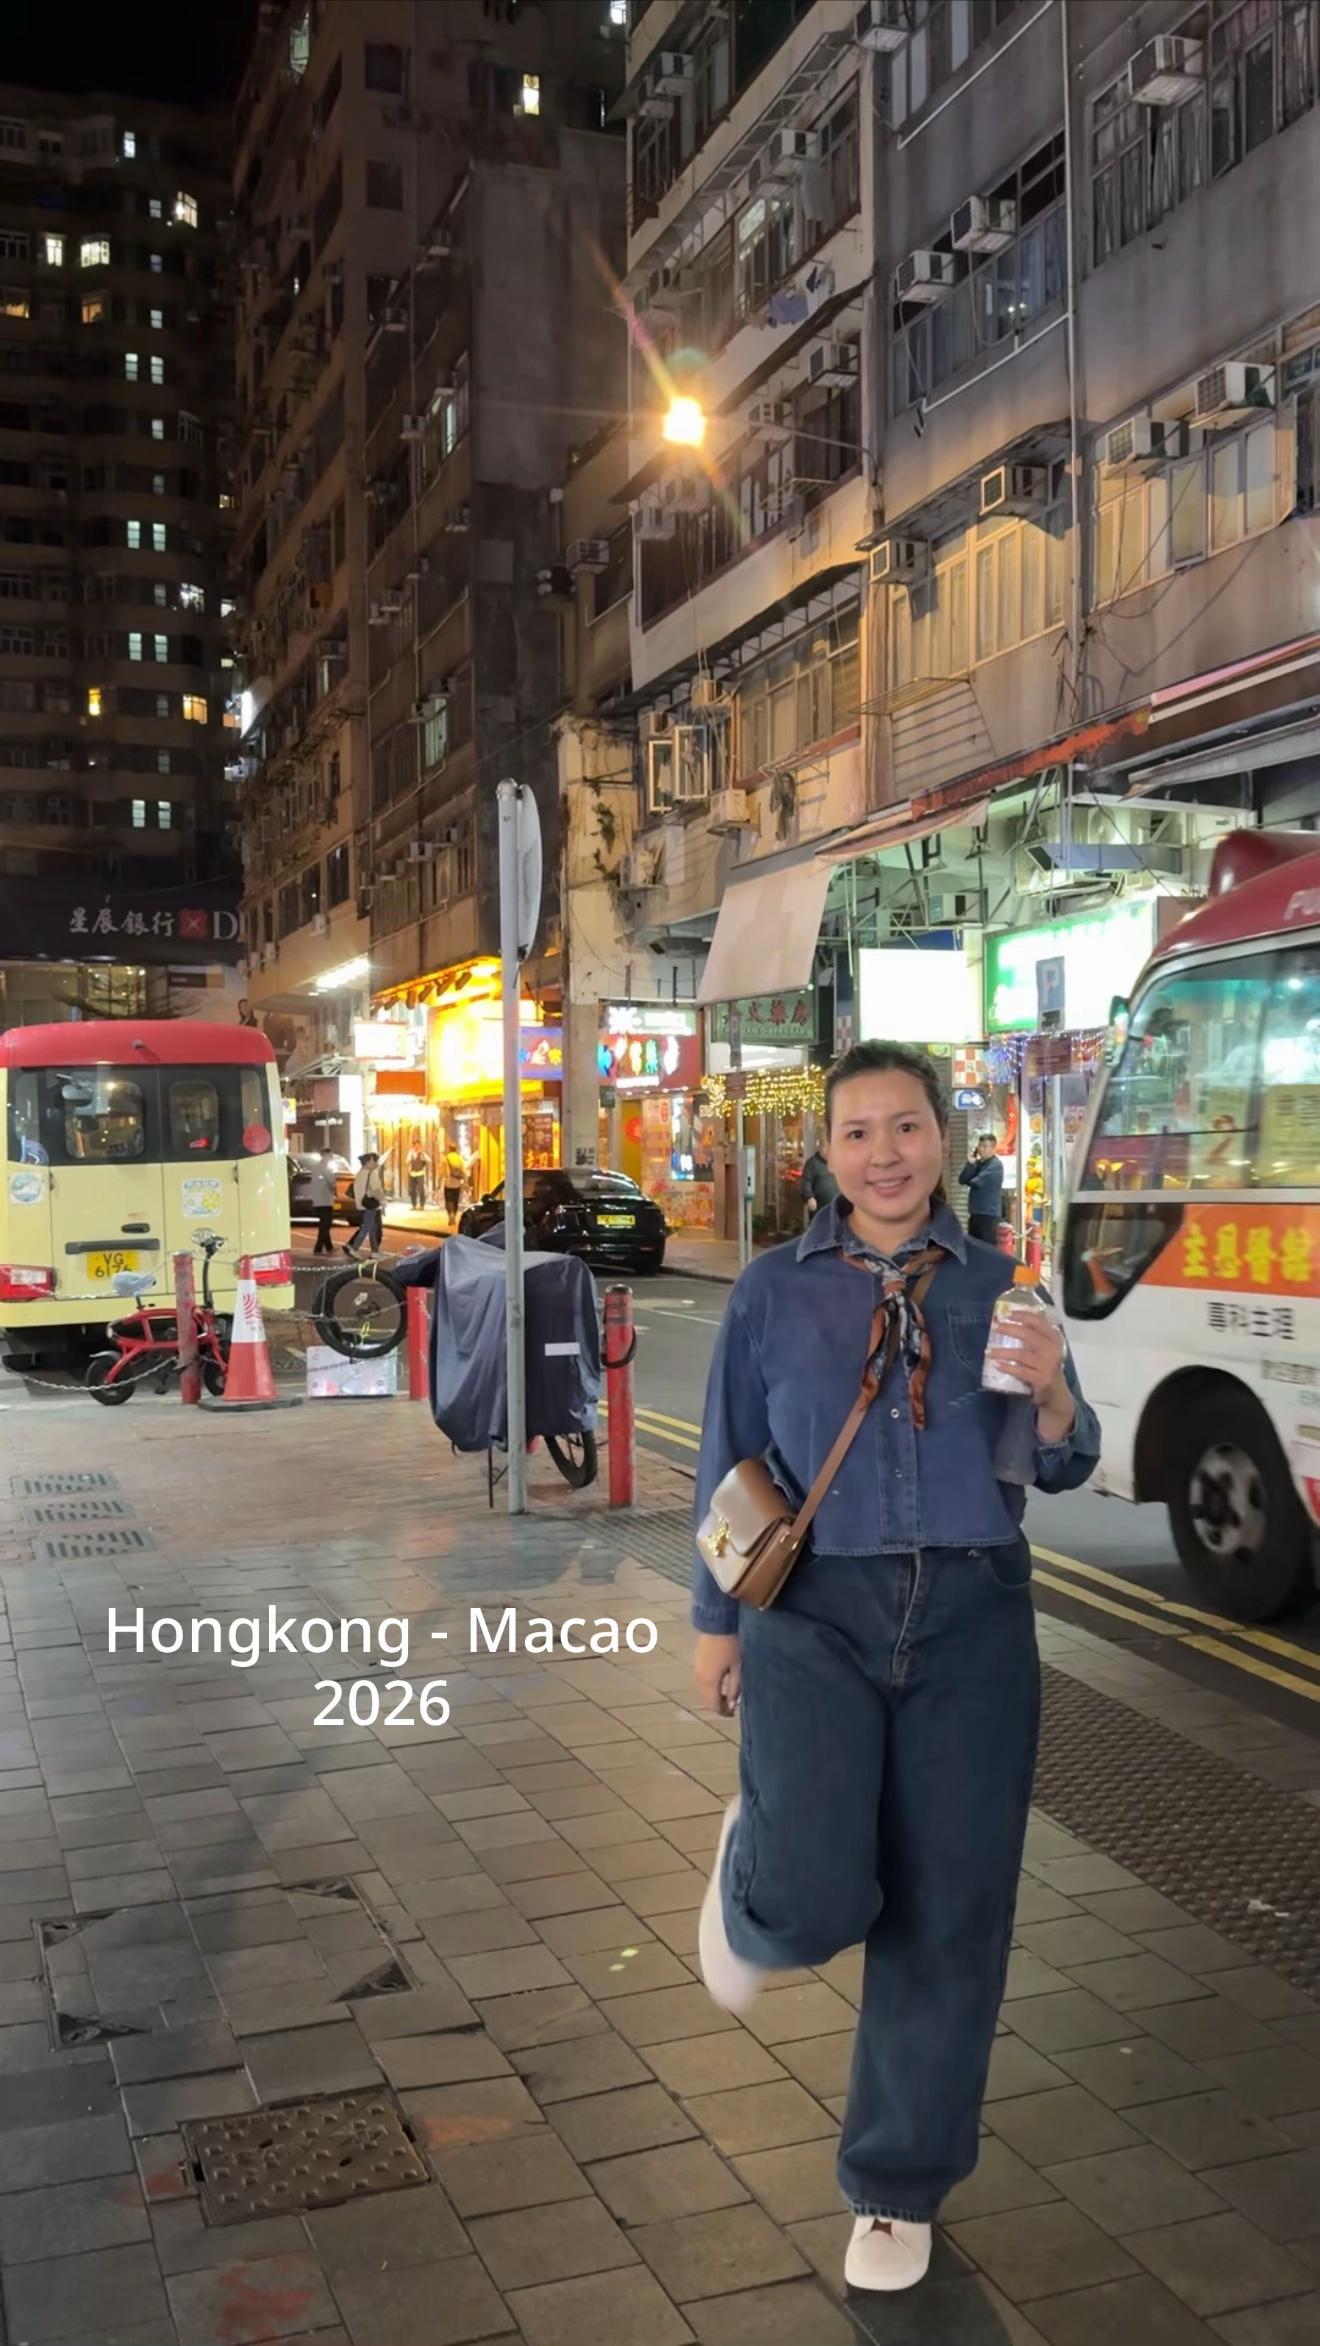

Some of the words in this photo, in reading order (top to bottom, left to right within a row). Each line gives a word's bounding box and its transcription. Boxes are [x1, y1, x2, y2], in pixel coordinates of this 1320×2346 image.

[69, 907, 175, 937] 星展銀行
[213, 911, 241, 940] D
[103, 1252, 124, 1265] VG
